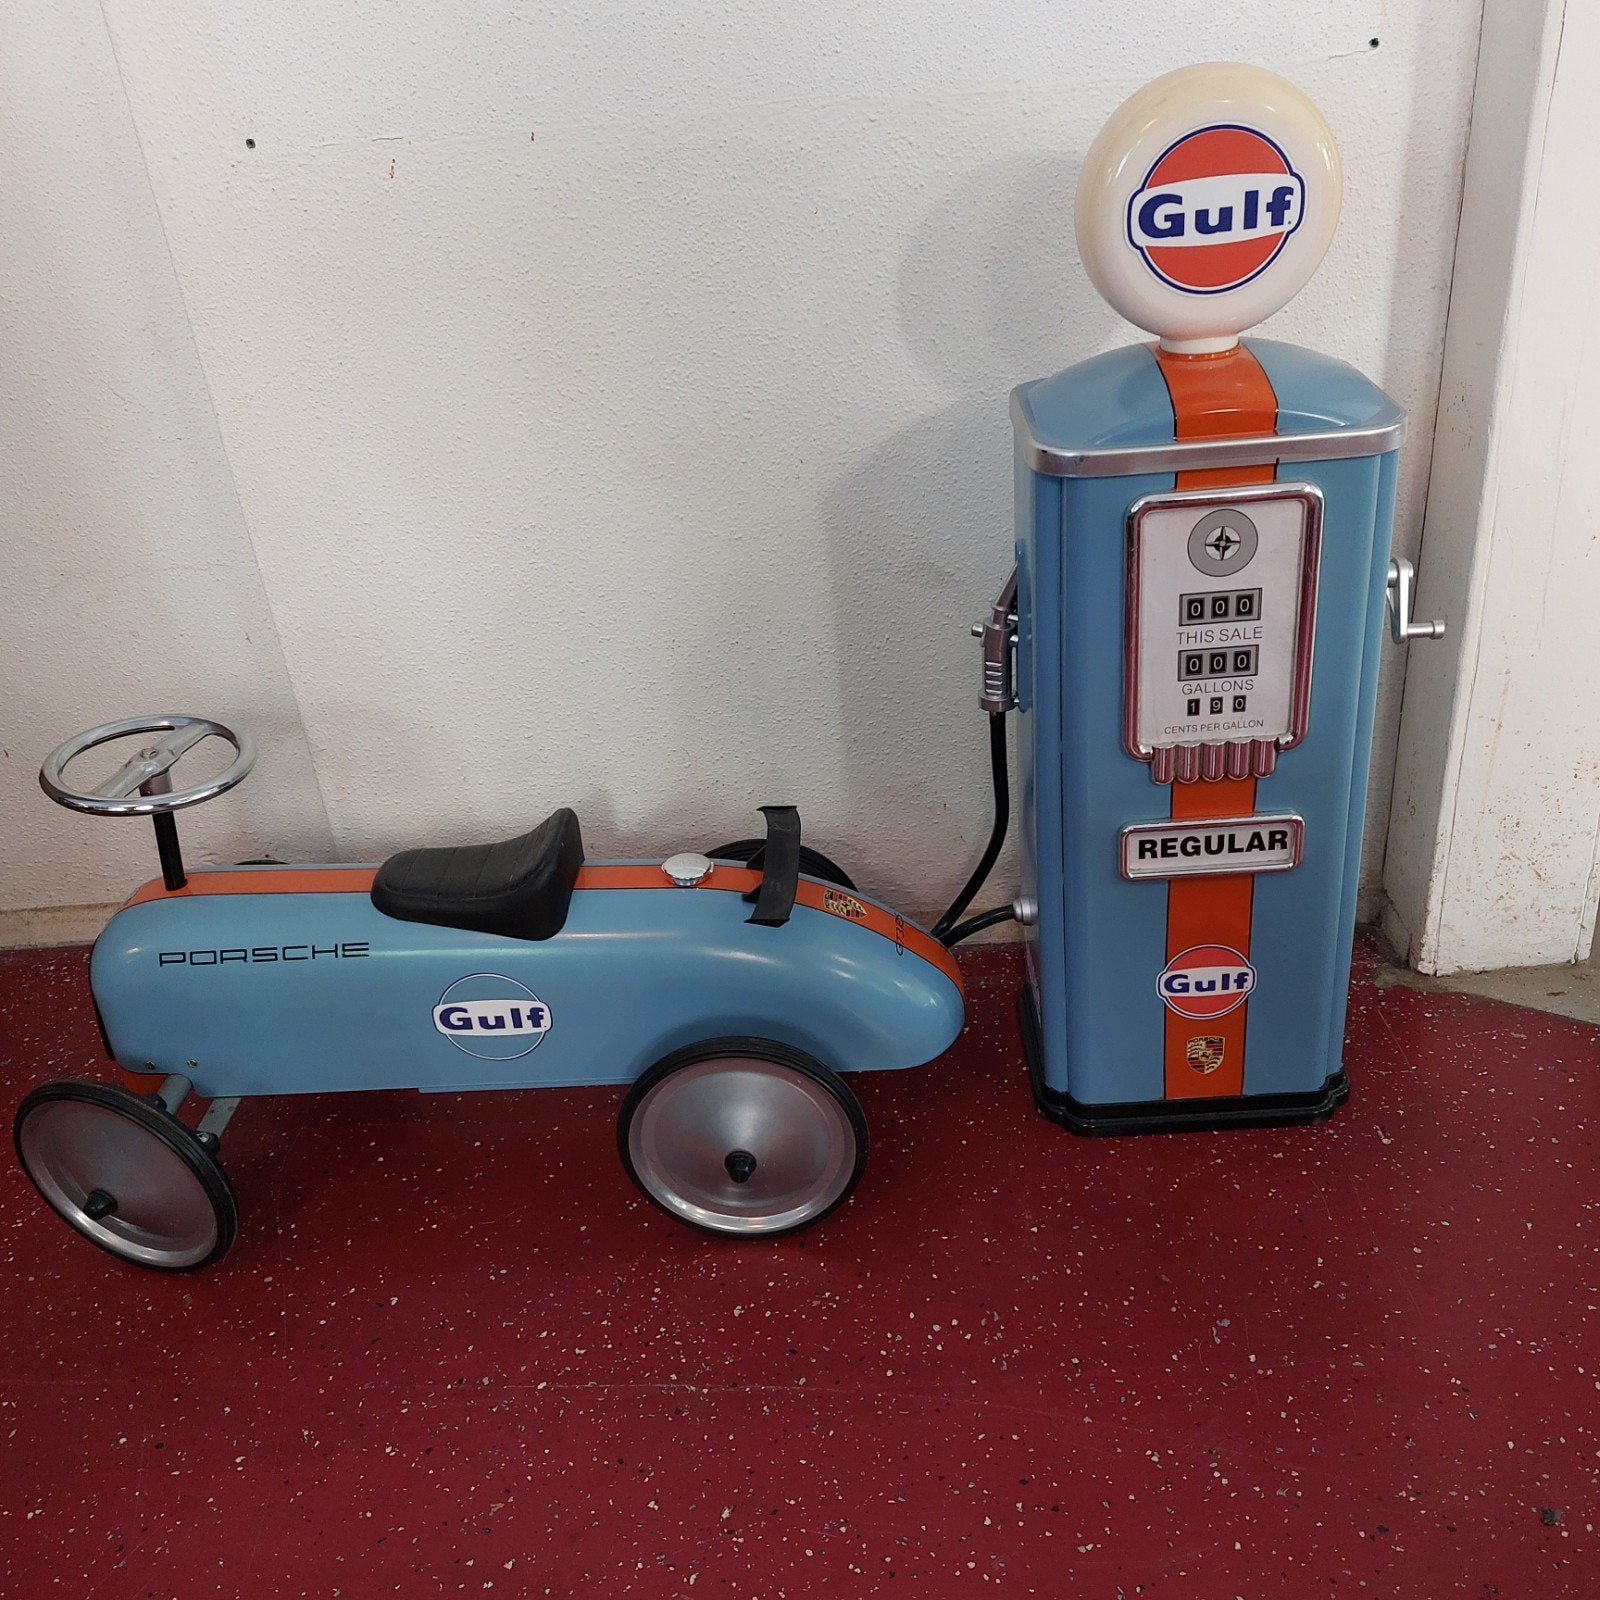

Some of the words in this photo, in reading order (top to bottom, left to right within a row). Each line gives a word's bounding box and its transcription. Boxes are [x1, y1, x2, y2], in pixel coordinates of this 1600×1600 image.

[1138, 185, 1294, 239] Gulf
[1176, 629, 1214, 646] THIS
[1219, 626, 1264, 643] SALE
[1182, 679, 1254, 696] GALLONS
[1164, 724, 1198, 735] CENTS
[1200, 722, 1220, 732] PER
[1222, 719, 1264, 731] GALLON
[1138, 829, 1289, 860] REGULAR
[159, 942, 370, 968] PORSCHE
[1163, 971, 1250, 994] Gulf
[438, 1005, 545, 1031] Gulf
